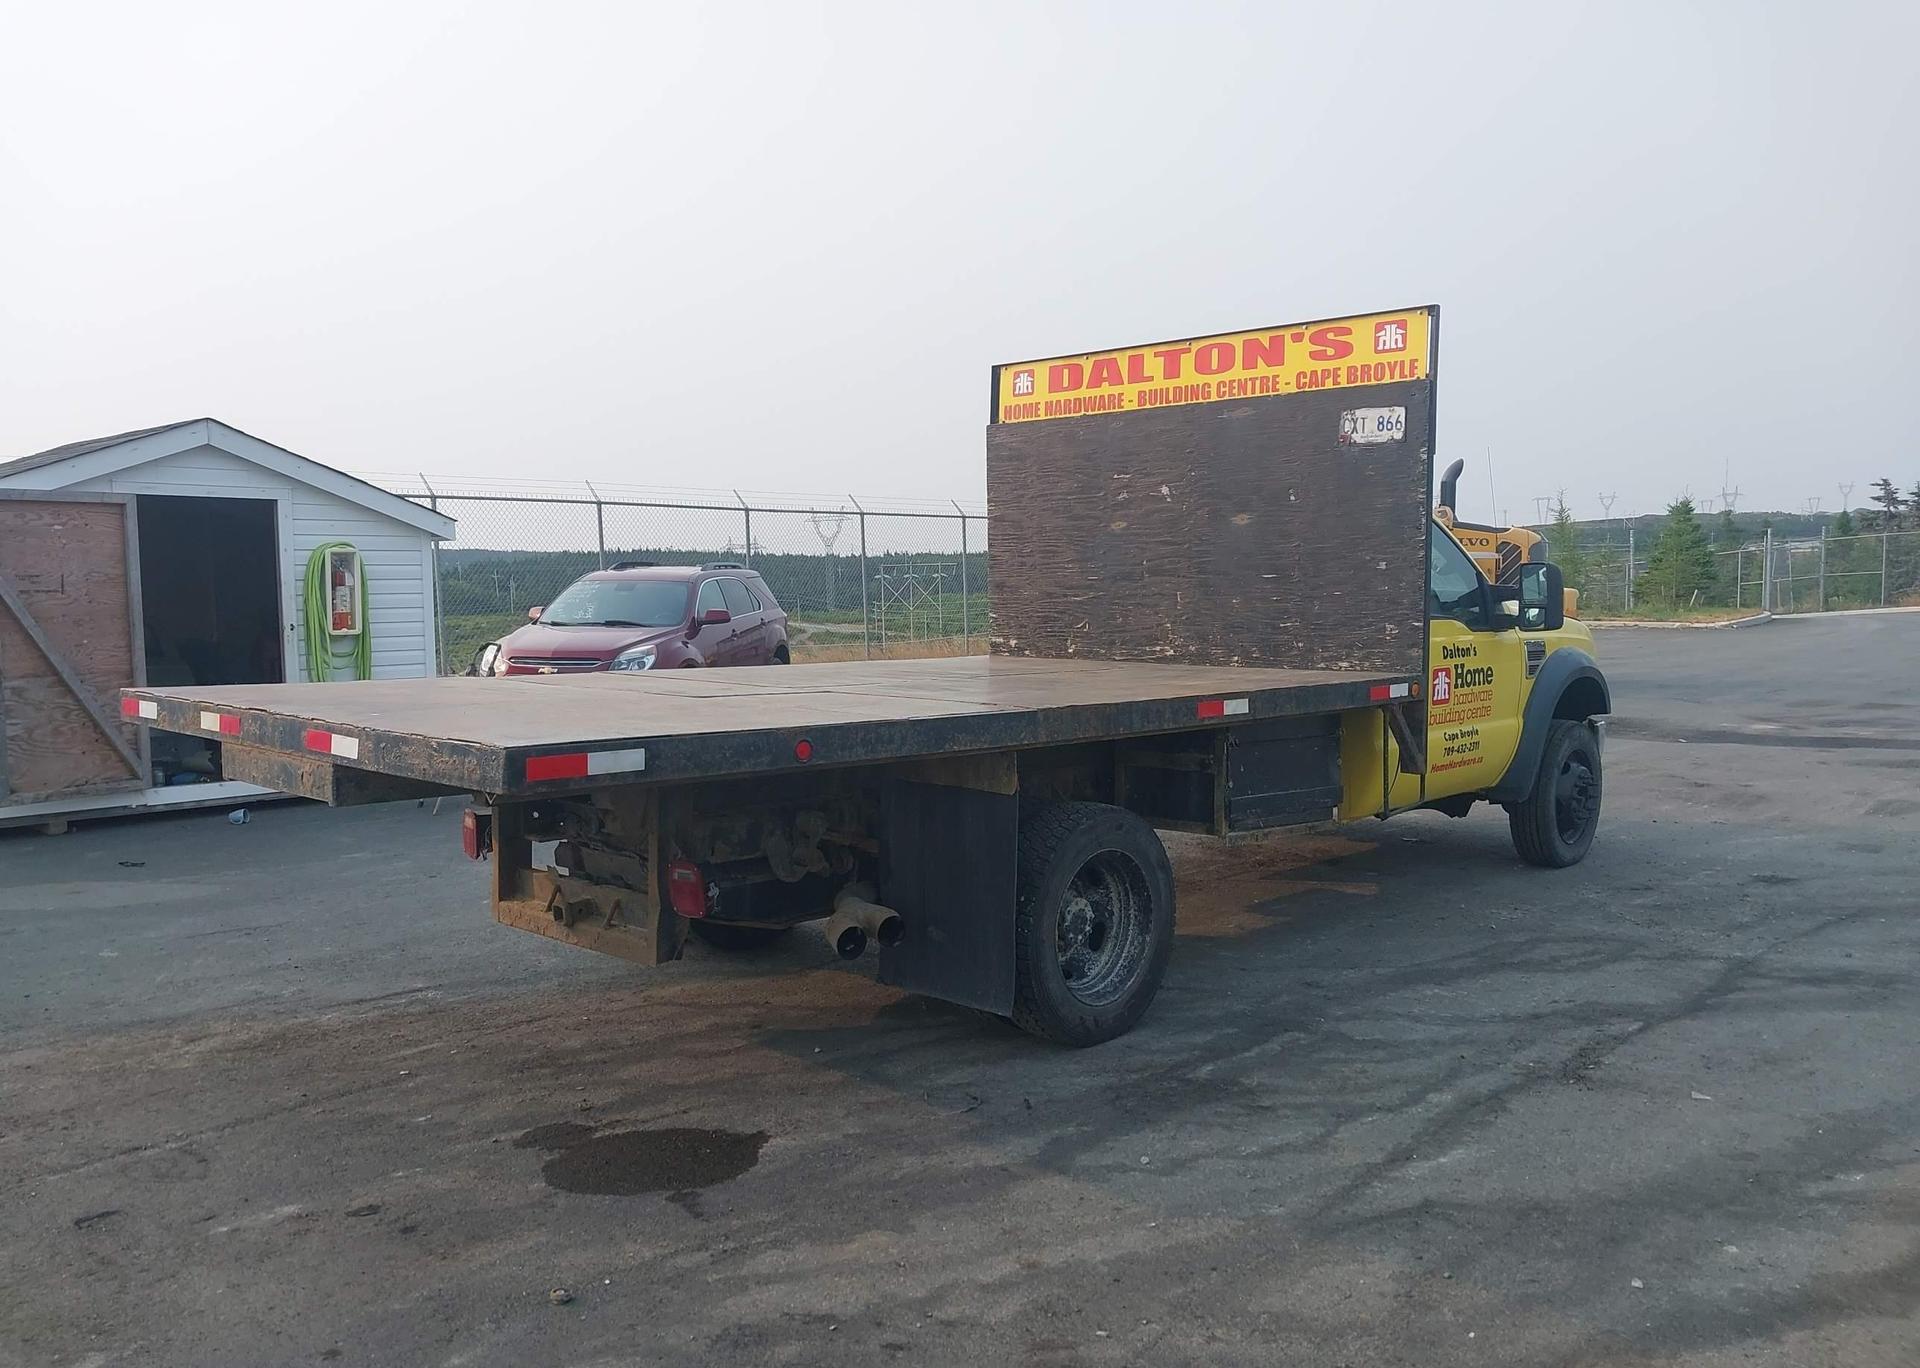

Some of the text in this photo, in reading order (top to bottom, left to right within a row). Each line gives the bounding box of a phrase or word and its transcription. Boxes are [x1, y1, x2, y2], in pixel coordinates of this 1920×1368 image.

[1048, 326, 1354, 394] DALTON'S
[1003, 401, 1041, 421] HOME
[1044, 392, 1125, 417] HARDWARE
[1137, 382, 1212, 408] BUILDING
[1216, 374, 1280, 399] CENTRE
[1295, 366, 1341, 390] CAPE
[1346, 358, 1419, 385] BROYLE
[1343, 414, 1403, 435] CXT 866
[1442, 643, 1478, 660] Dalton's
[1453, 663, 1494, 690] Home
[1453, 689, 1494, 706] hardware
[1429, 705, 1492, 726] building centre
[1443, 725, 1480, 744] Cape Broyle
